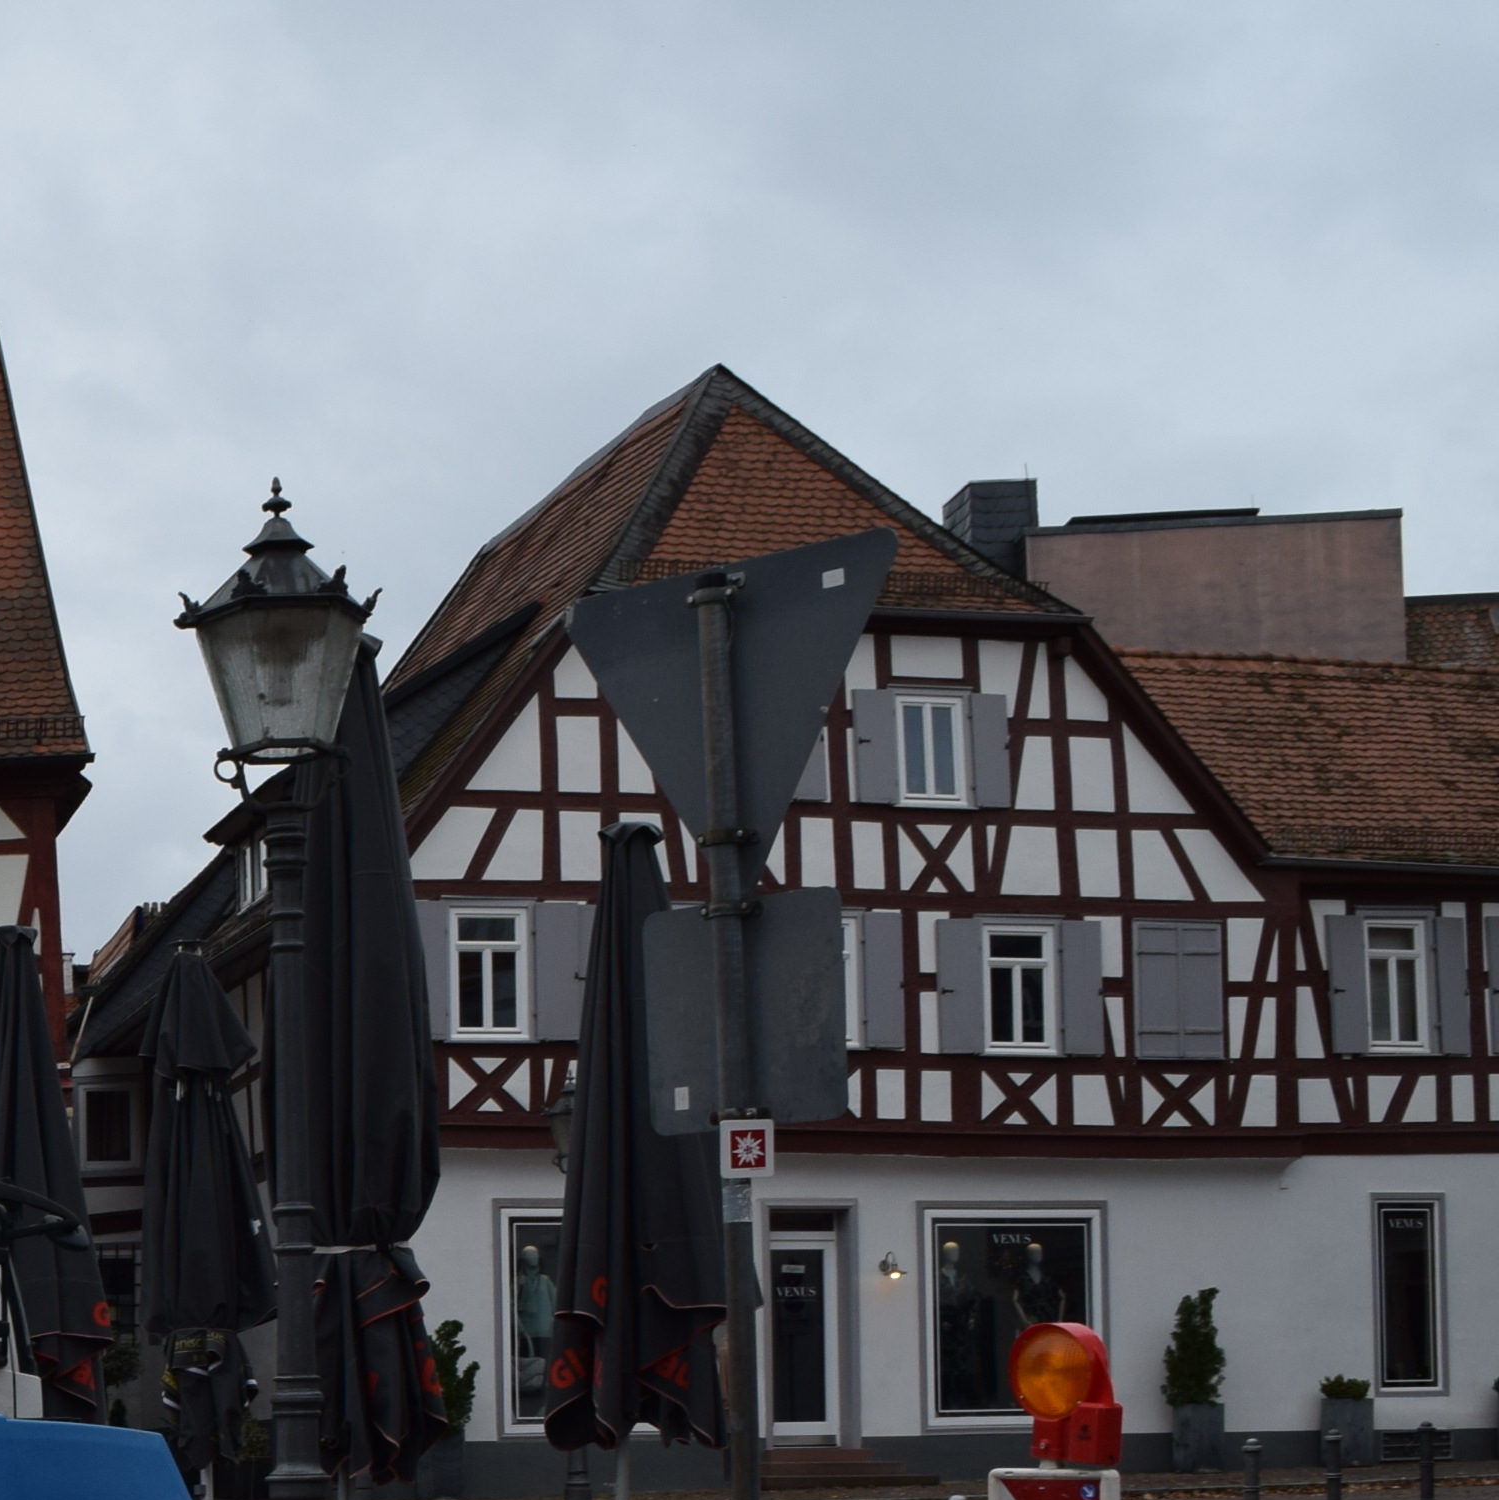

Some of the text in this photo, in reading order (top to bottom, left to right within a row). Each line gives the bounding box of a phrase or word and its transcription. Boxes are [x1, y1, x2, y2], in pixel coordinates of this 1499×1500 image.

[1388, 1218, 1424, 1229] VENUS
[992, 1233, 1032, 1244] VENUS
[775, 1286, 818, 1297] VENUS
